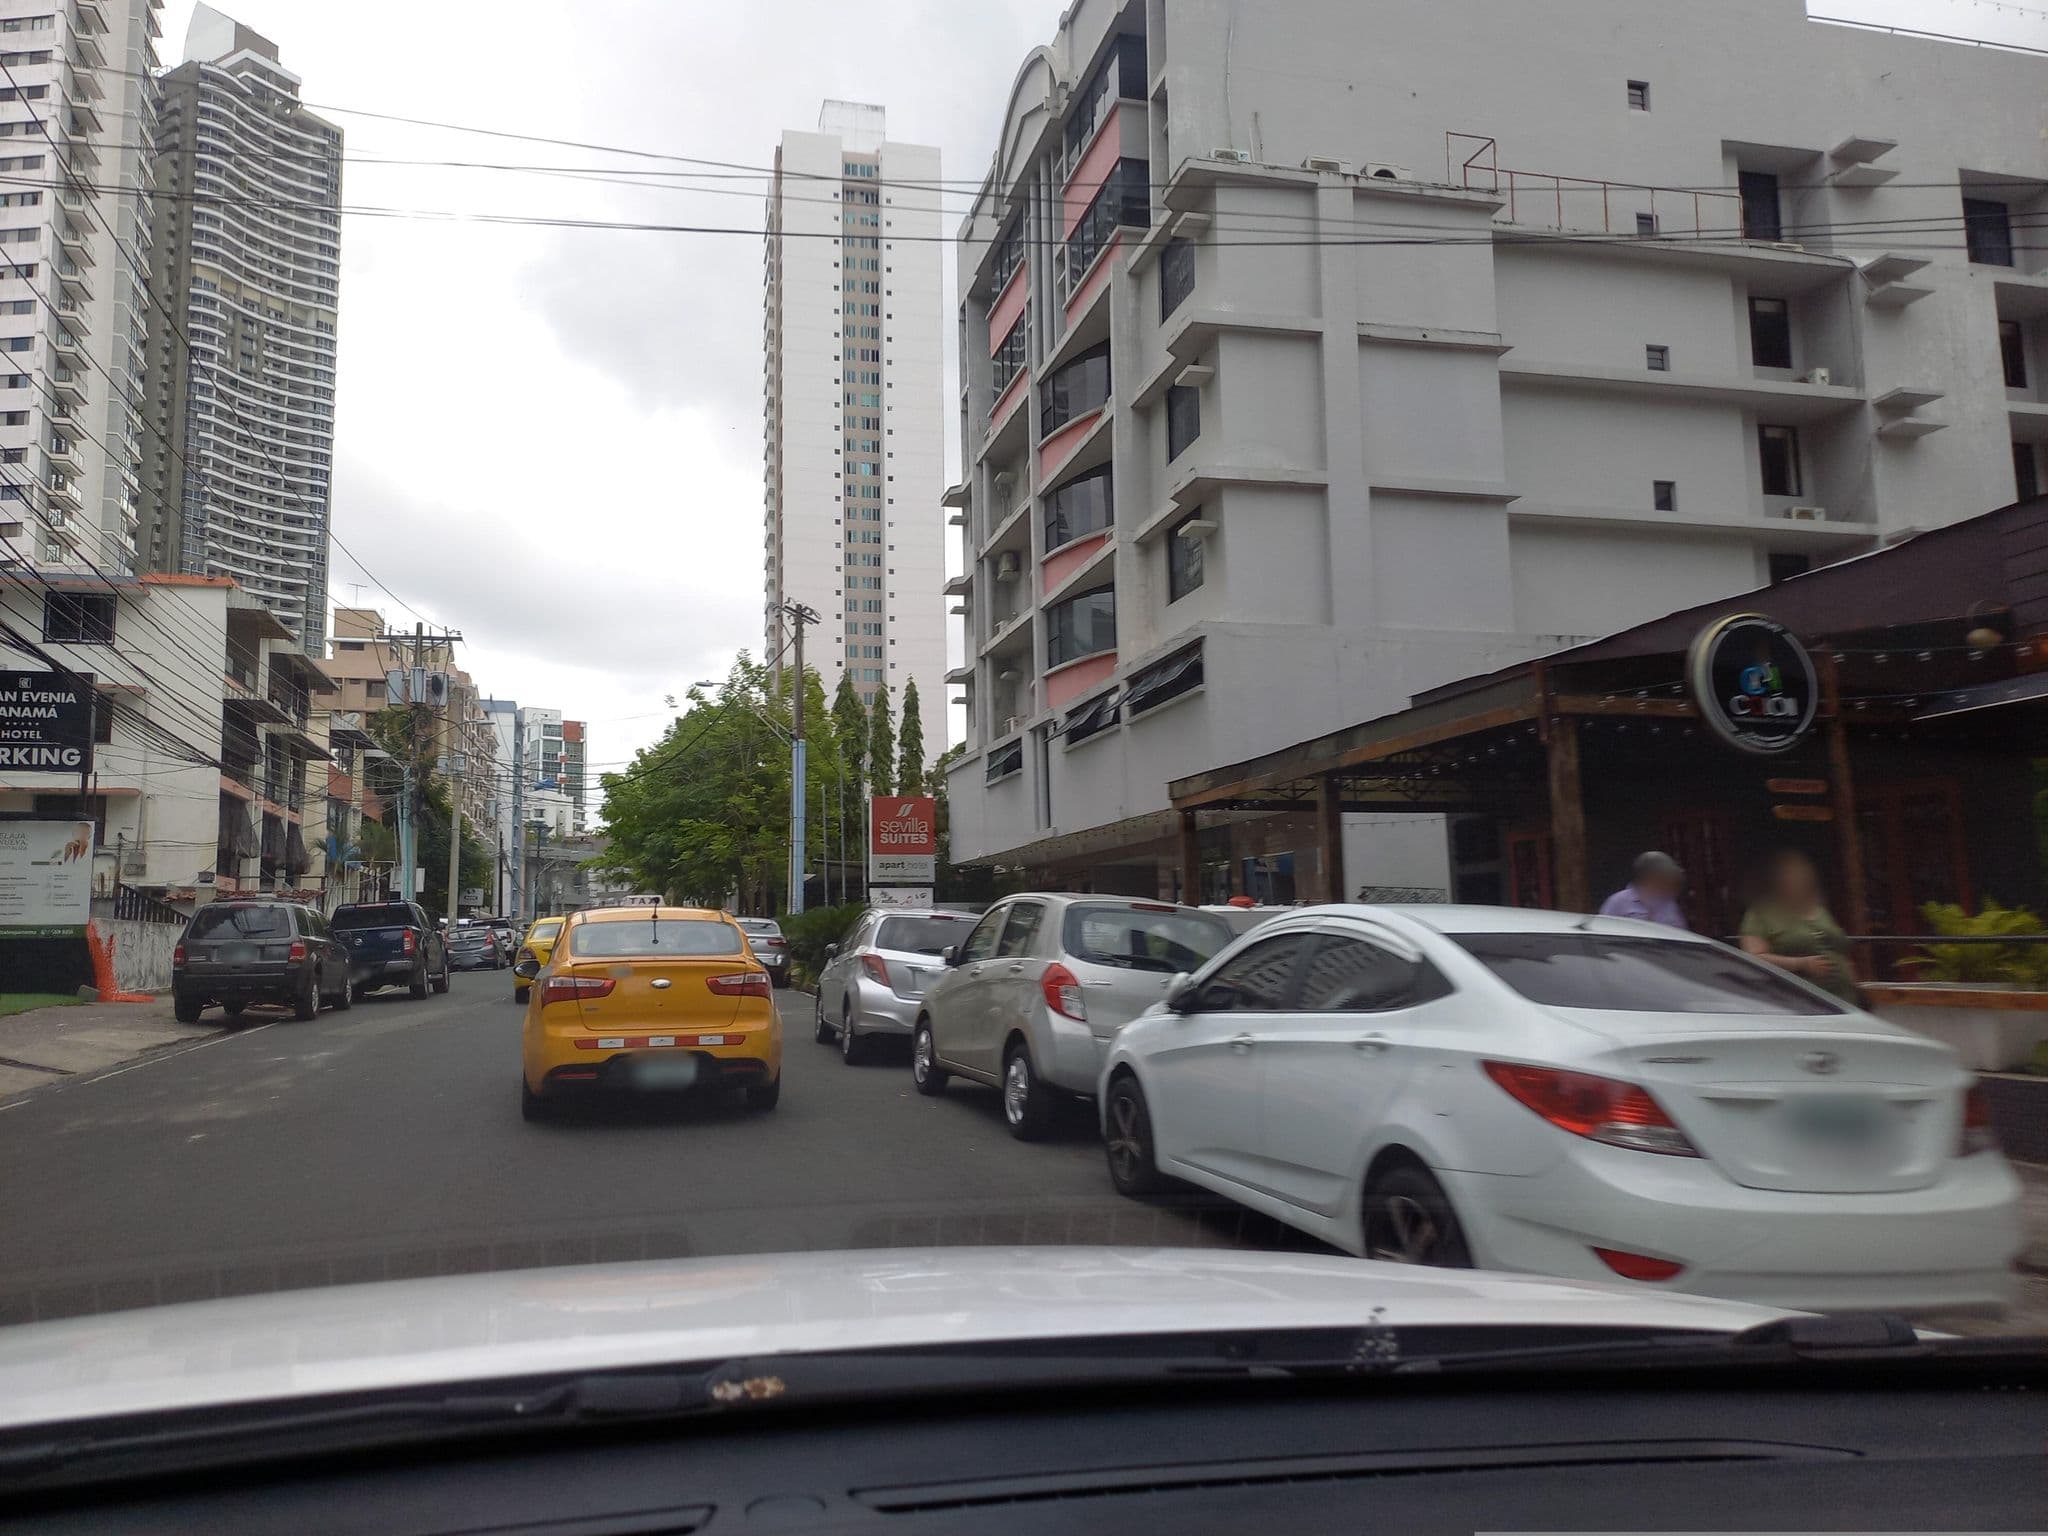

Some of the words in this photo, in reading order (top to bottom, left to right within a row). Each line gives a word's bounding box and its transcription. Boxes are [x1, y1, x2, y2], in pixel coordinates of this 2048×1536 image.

[22, 691, 77, 704] EVENIA
[0, 704, 58, 718] ANAMÁ
[1, 730, 42, 739] HOTEL
[0, 747, 81, 766] RKING
[880, 817, 929, 833] sevilla
[880, 833, 928, 844] SUITES
[629, 897, 661, 905] TAX
